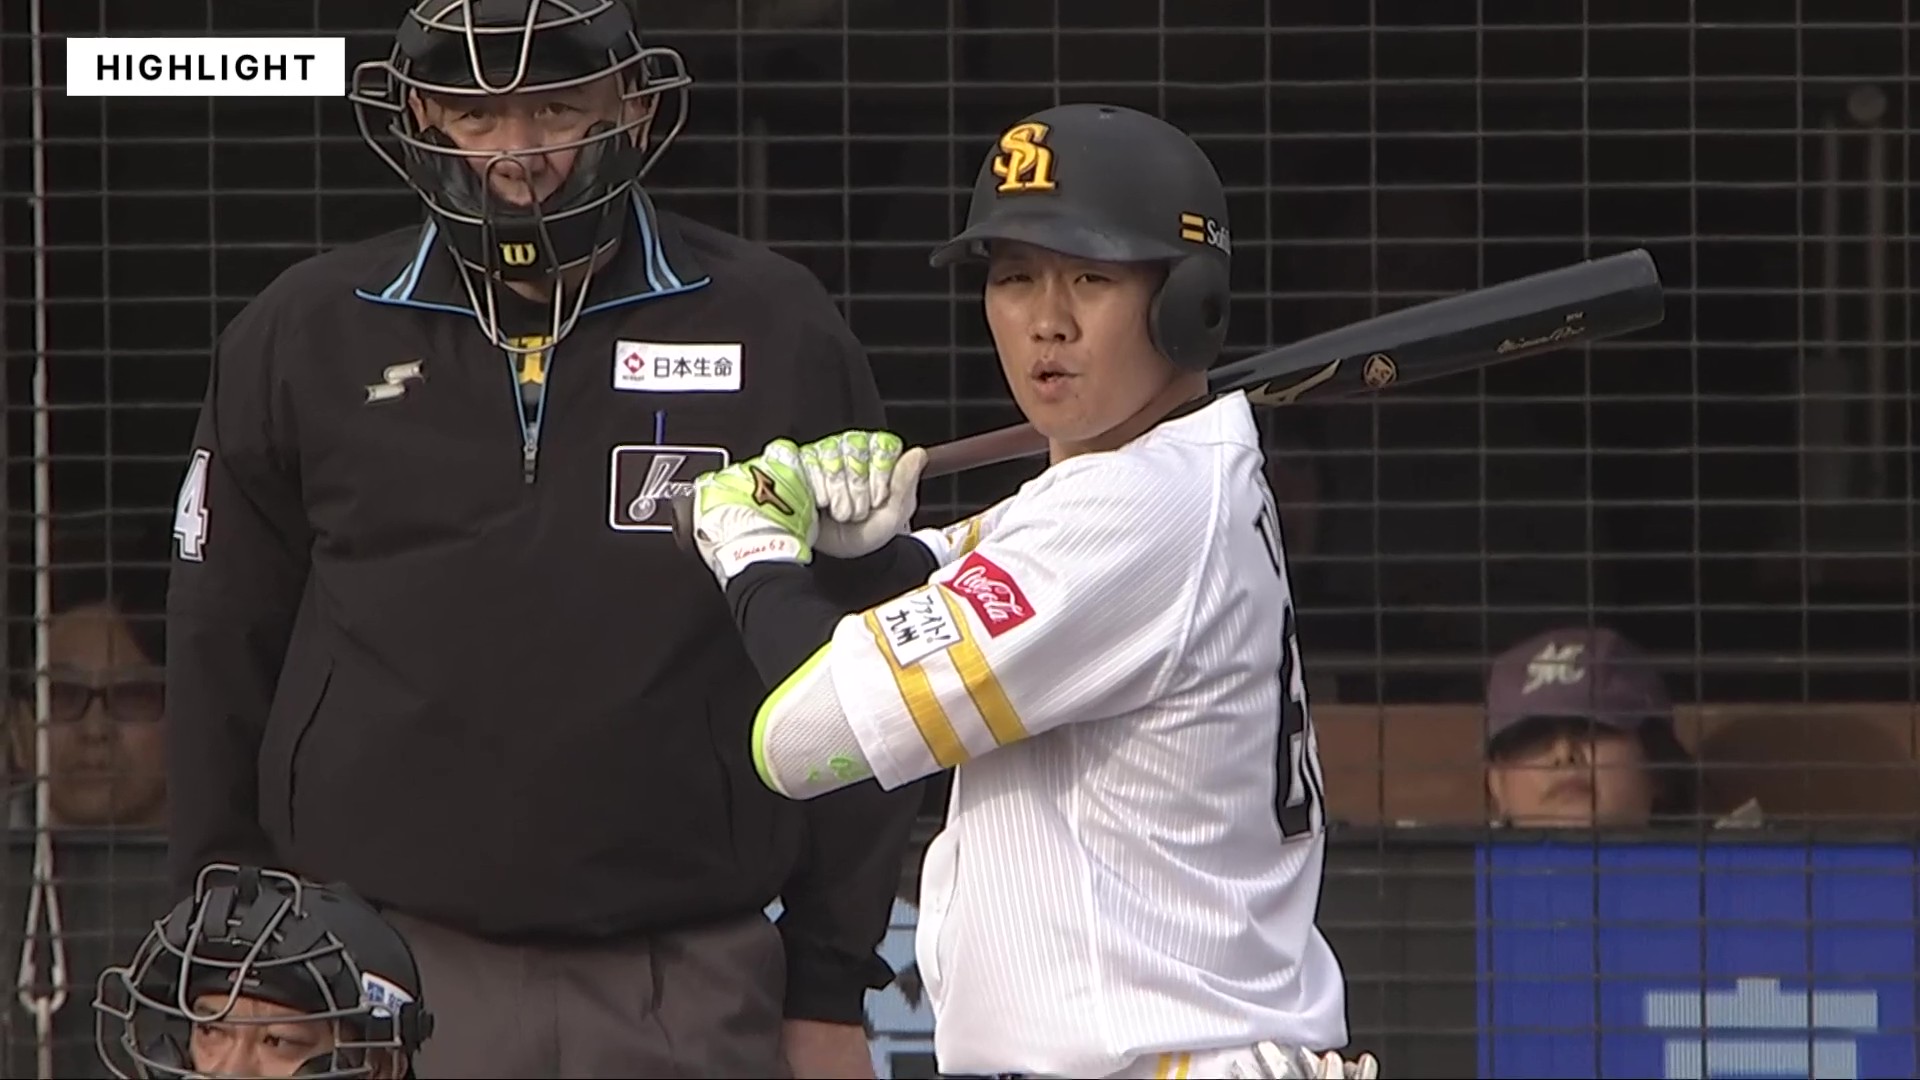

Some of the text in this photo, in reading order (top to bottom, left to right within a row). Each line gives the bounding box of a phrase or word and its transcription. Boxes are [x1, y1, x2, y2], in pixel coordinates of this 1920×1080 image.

[653, 356, 734, 379] 日本生命
[172, 448, 211, 562] 4
[885, 608, 920, 647] 九州
